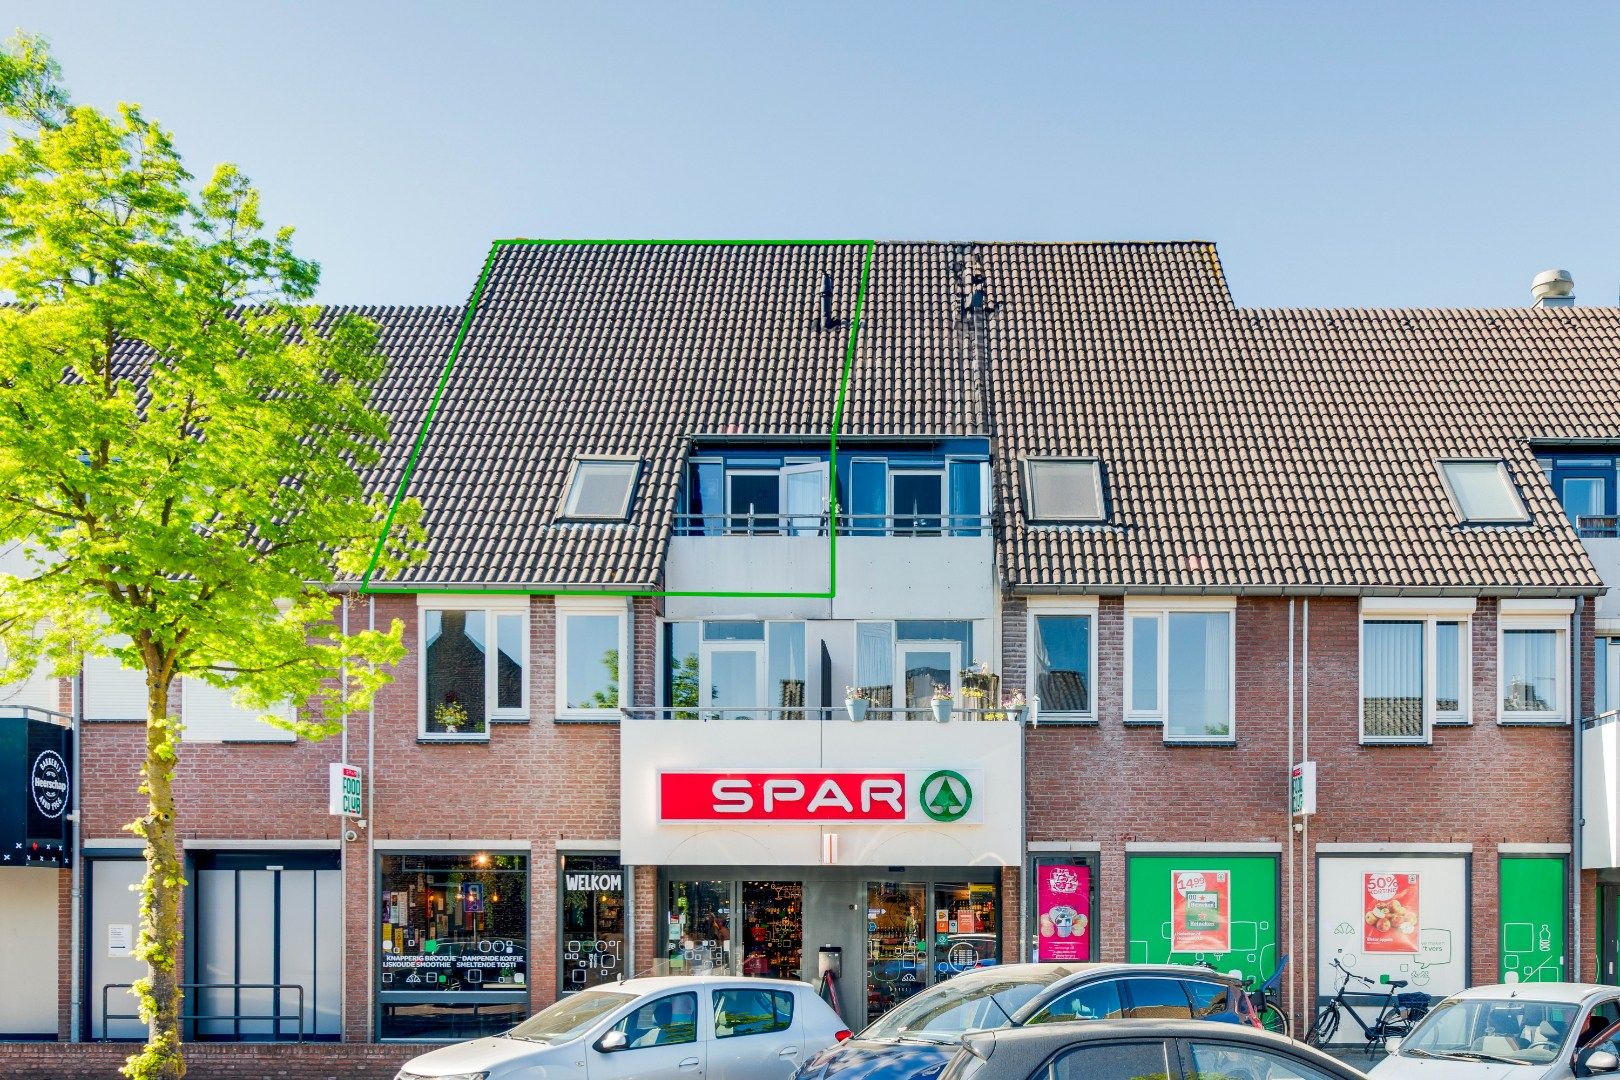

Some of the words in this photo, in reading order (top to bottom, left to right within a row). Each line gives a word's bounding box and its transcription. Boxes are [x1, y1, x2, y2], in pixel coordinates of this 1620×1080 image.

[35, 776, 66, 792] Heerschap
[343, 777, 360, 796] FOOD
[343, 795, 360, 815] CLUB
[711, 779, 903, 813] SPAR
[565, 874, 622, 891] WELKOM
[1368, 876, 1398, 890] 50%
